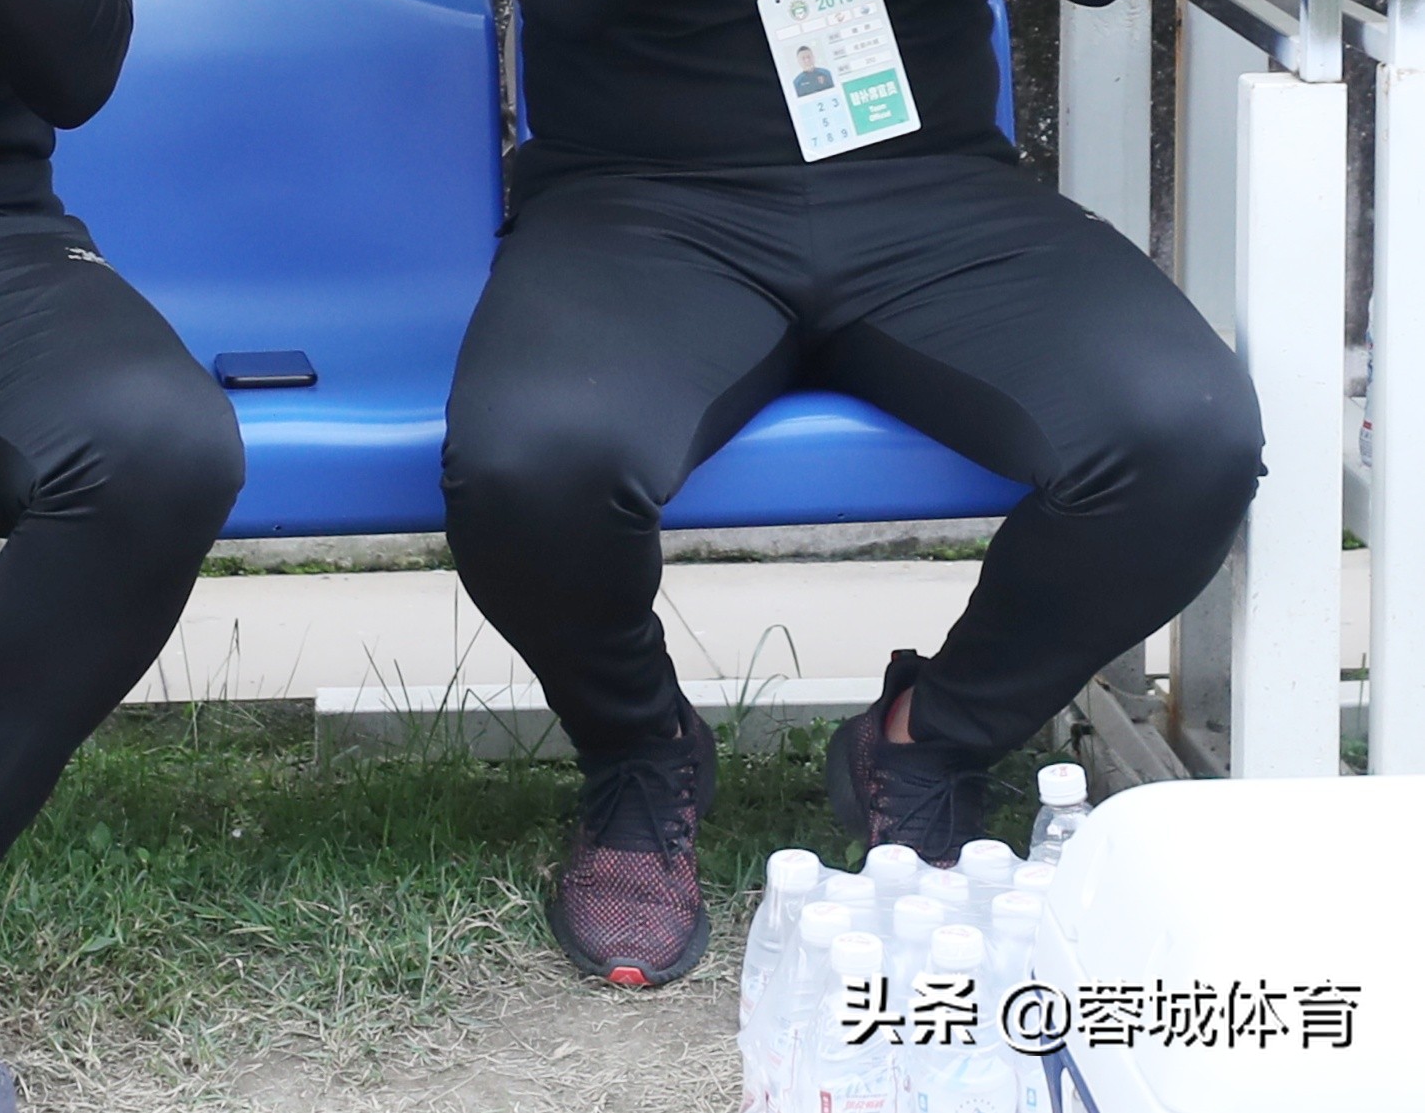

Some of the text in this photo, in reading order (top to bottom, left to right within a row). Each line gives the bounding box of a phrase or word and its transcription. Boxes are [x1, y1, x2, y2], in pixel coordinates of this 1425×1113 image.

[818, 98, 840, 112] 2 3
[822, 117, 829, 127] 5
[811, 129, 848, 147] 7 8 9
